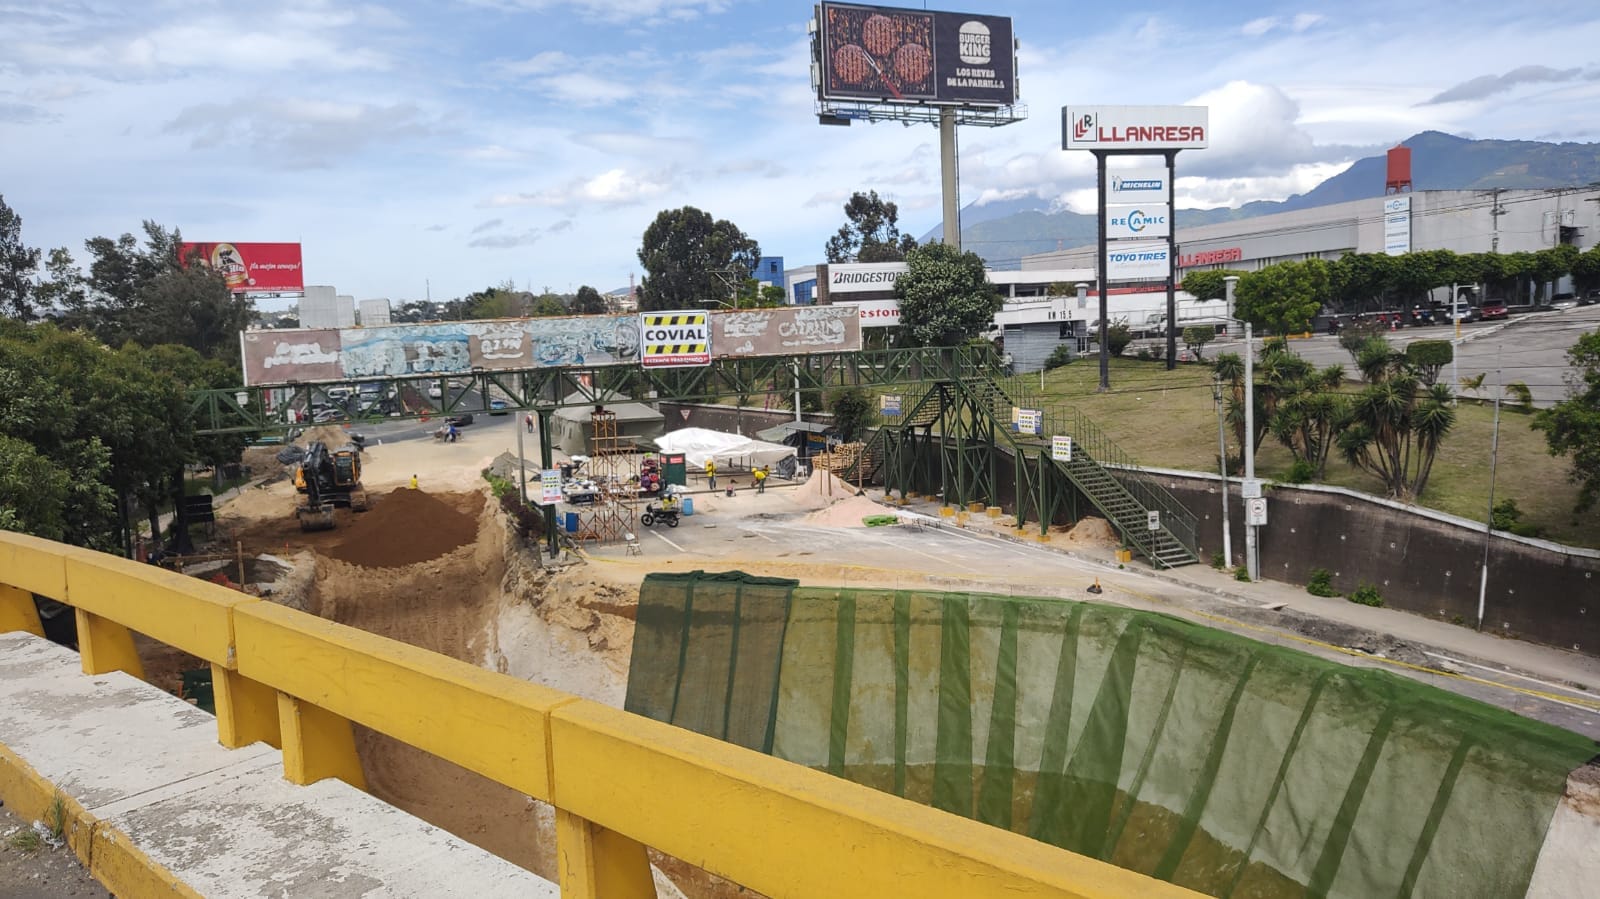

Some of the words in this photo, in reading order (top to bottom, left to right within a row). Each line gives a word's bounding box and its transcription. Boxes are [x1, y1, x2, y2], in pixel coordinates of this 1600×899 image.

[960, 33, 991, 45] BURGER
[960, 43, 991, 56] KING
[956, 68, 971, 77] LOS
[971, 69, 995, 78] REYES
[947, 78, 957, 87] DE
[1099, 126, 1204, 142] LLANRESA
[1122, 181, 1161, 189] MICHELIN
[1111, 209, 1165, 232] RECAMIC
[1109, 254, 1137, 262] TOYO
[1138, 252, 1167, 261] TIRES
[1179, 248, 1242, 267] LLANRESA
[833, 271, 909, 284] BRIDGESTO
[645, 329, 705, 341] COVIAL
